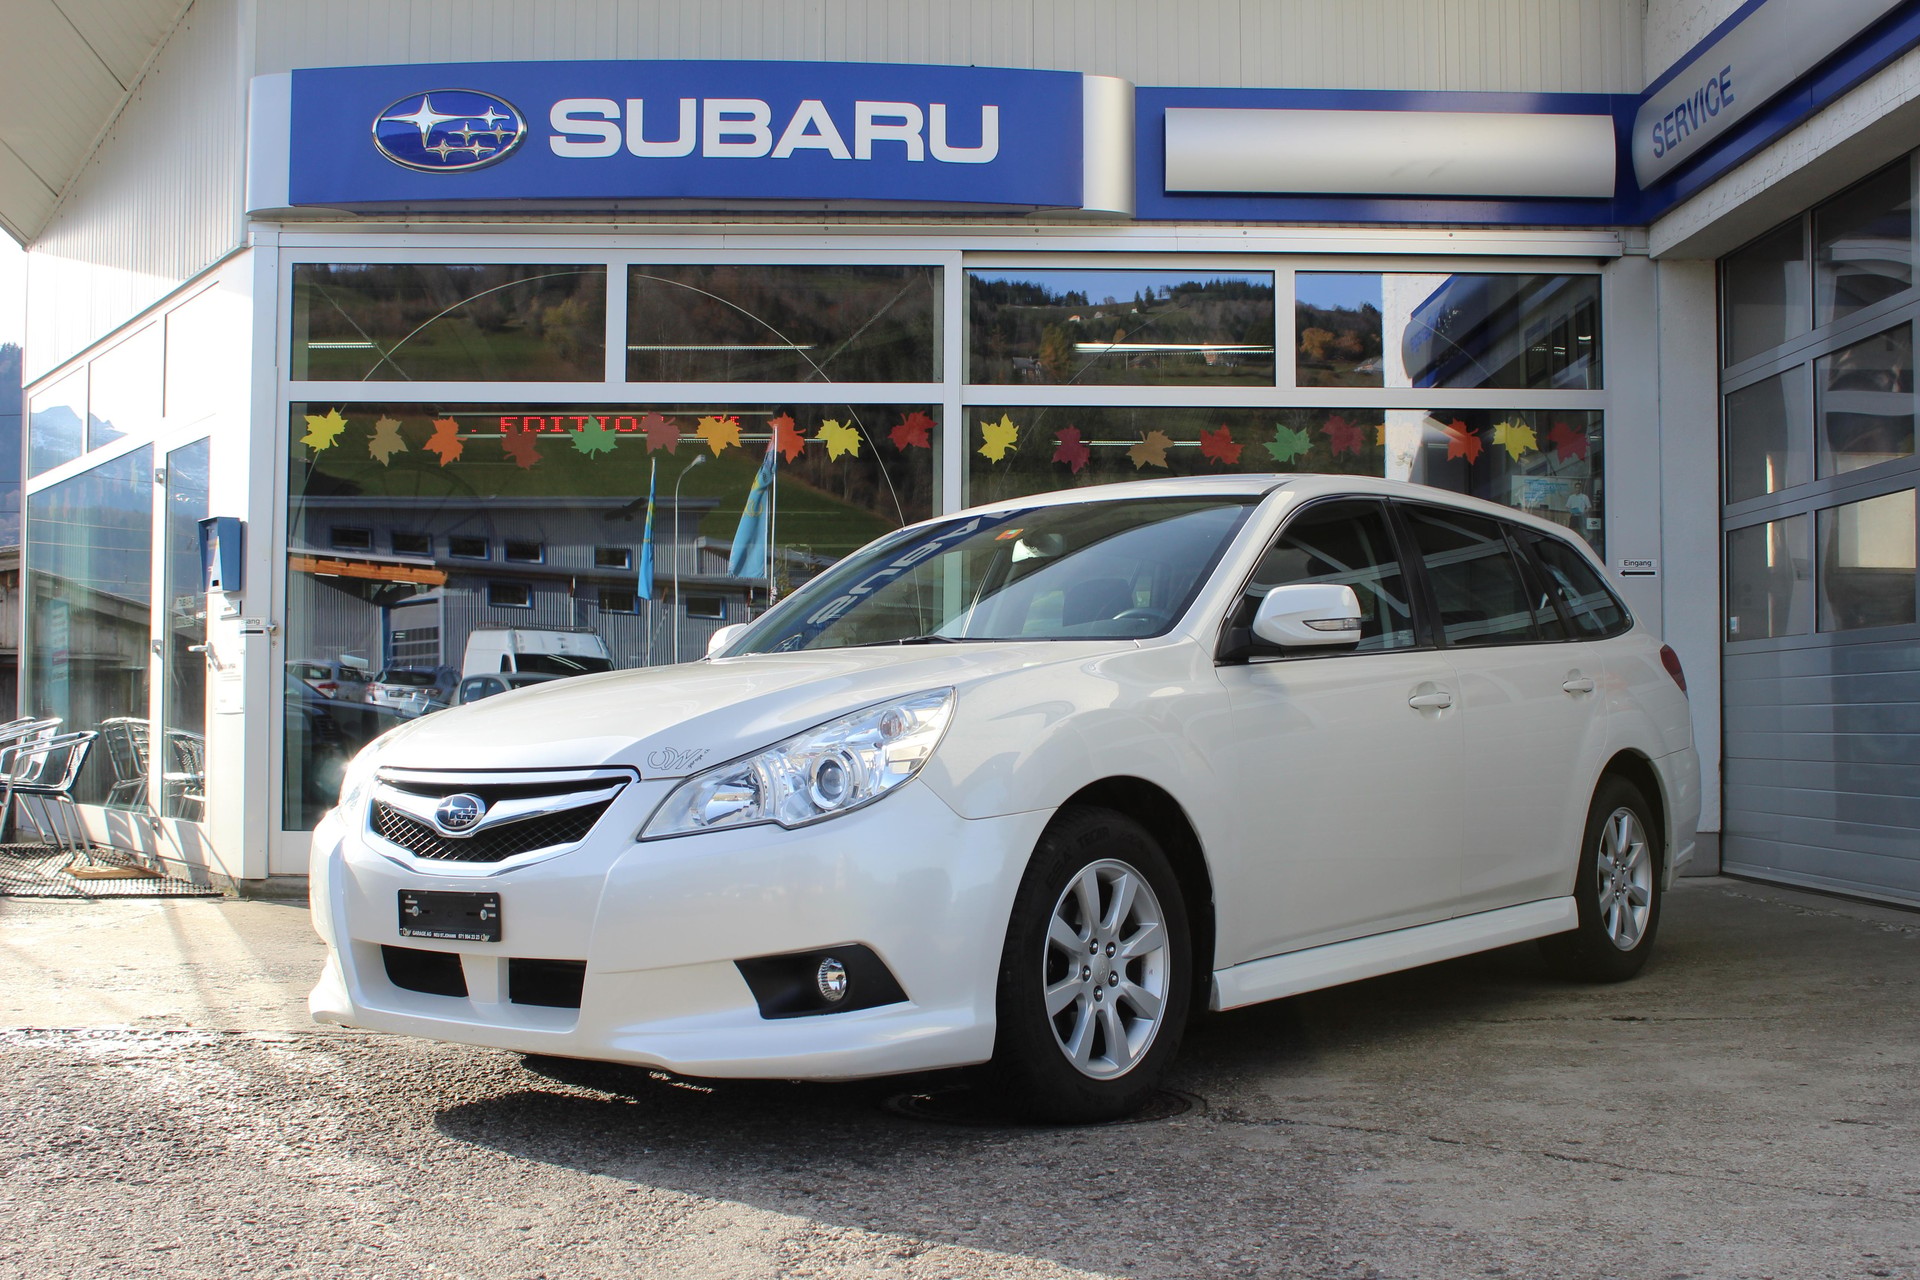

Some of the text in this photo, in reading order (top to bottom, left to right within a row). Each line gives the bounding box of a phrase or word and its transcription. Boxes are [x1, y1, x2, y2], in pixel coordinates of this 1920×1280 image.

[549, 98, 999, 164] SUBARU
[1652, 64, 1735, 159] SERVICE
[500, 416, 665, 433] EDITIO
[1623, 559, 1652, 568] Eingang
